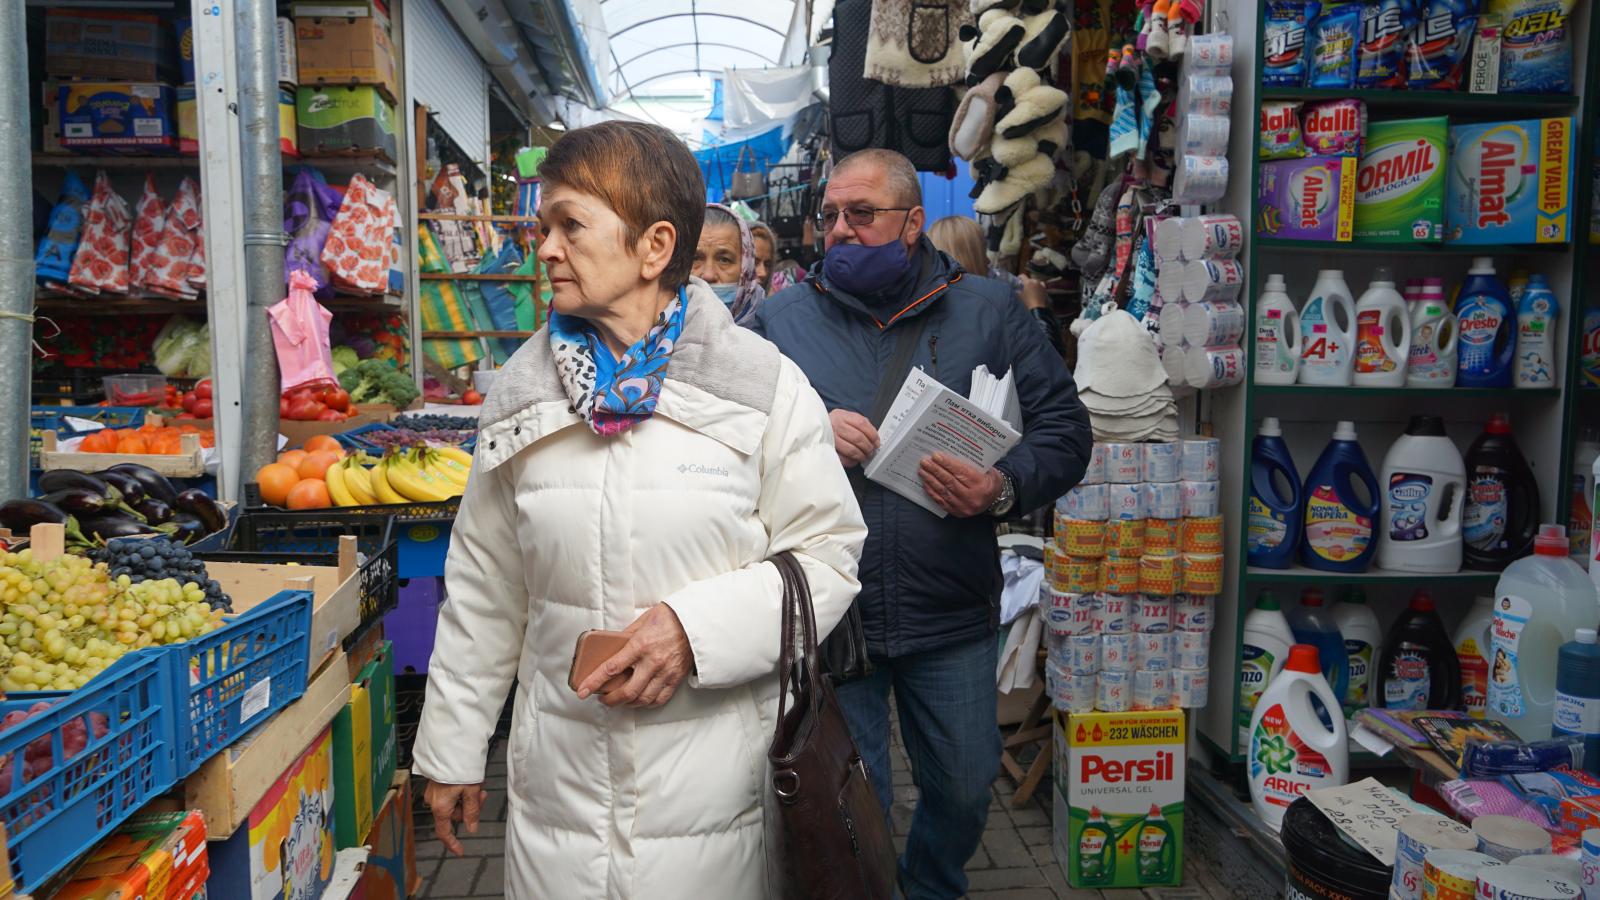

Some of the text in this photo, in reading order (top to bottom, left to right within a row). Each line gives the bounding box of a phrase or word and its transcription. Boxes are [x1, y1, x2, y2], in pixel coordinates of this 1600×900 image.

[1307, 108, 1355, 133] dalli
[1545, 120, 1563, 163] GREAT
[1357, 139, 1434, 192] ORMIL
[1365, 175, 1422, 199] BIOLOGICAL
[1479, 141, 1516, 228] Almat
[1543, 166, 1562, 209] VALUE
[1301, 175, 1323, 228] Almat
[1228, 223, 1240, 249] XXL
[977, 417, 1007, 440] виборця
[688, 464, 729, 477] Columbia
[1264, 715, 1282, 725] NEW
[1109, 725, 1179, 740] 232 WÄSCHEN
[1081, 751, 1173, 783] Persil
[1081, 785, 1153, 795] UNIVERSAL GEL
[1080, 841, 1102, 850] Persil
[1139, 839, 1161, 847] Persil
